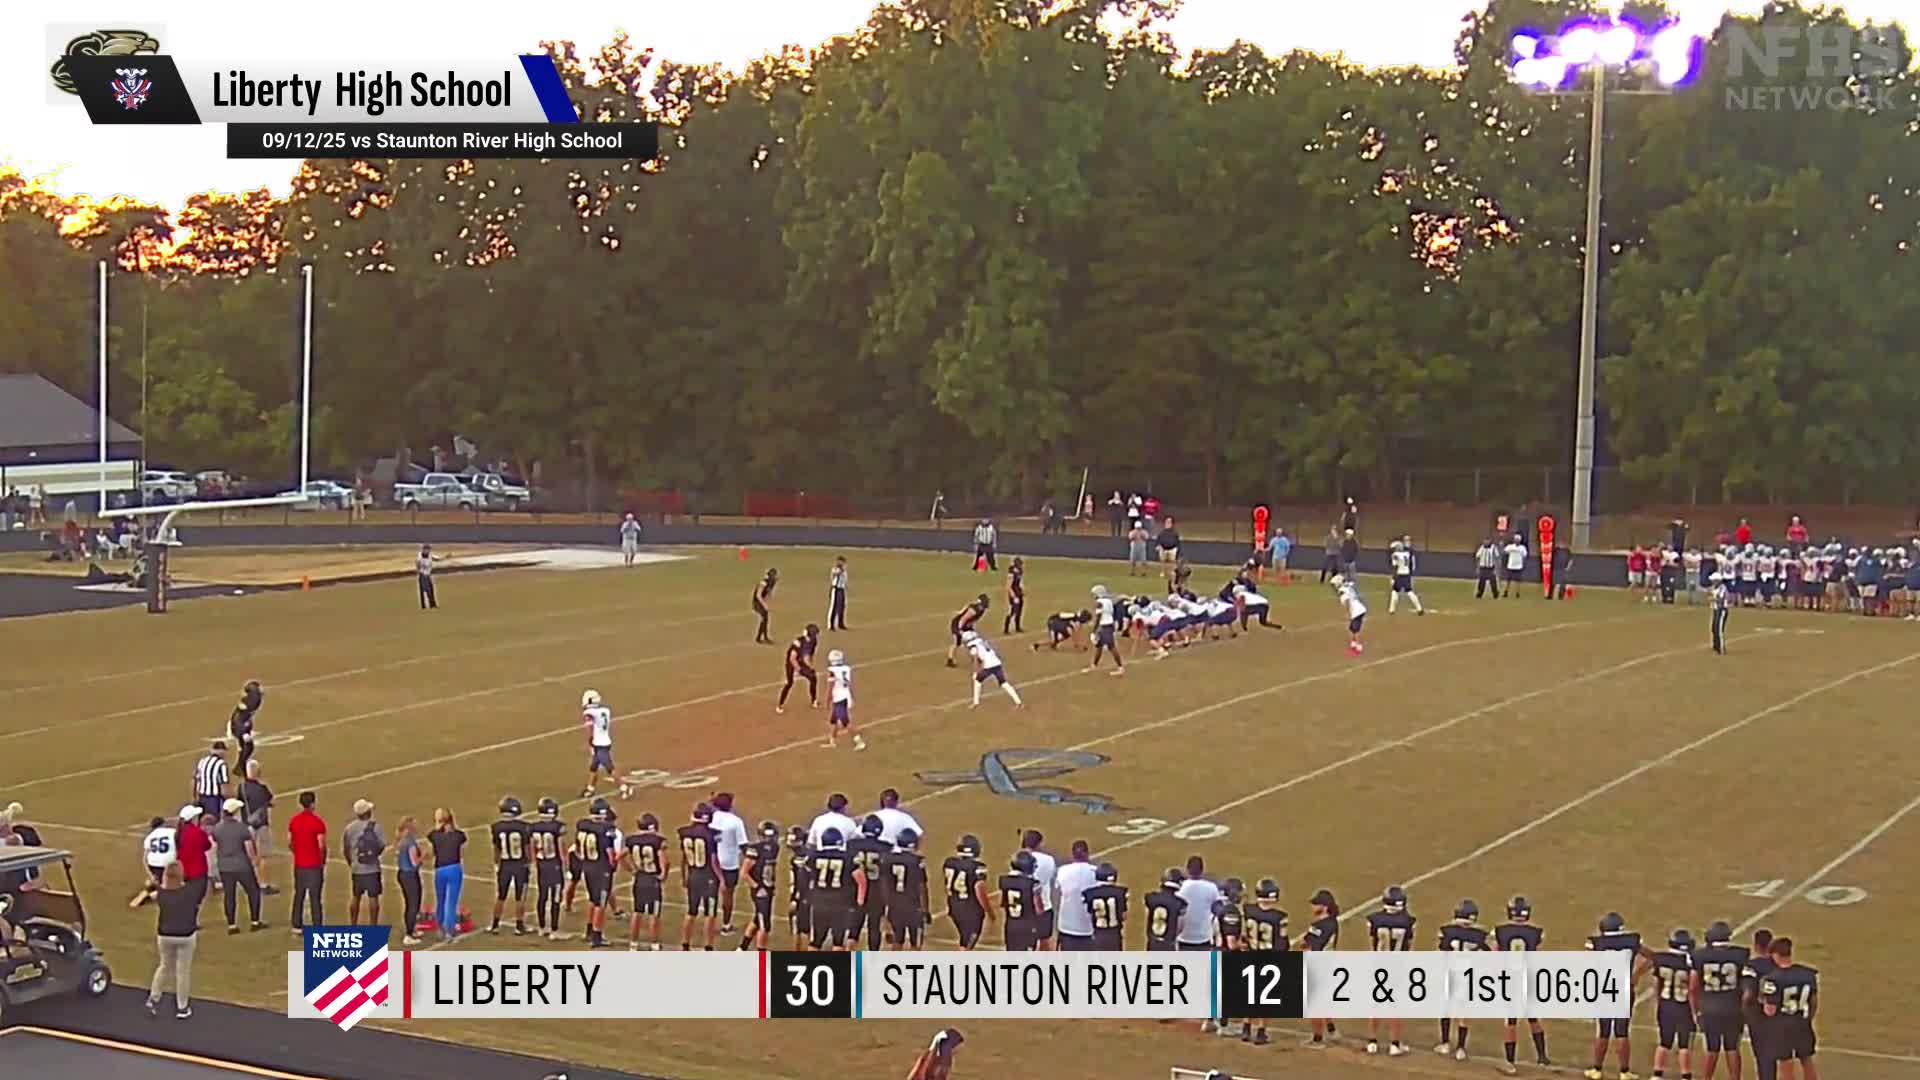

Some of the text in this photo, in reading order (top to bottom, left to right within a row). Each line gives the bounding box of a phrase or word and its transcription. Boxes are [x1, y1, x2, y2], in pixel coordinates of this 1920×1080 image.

[1106, 818, 1230, 840] 30
[815, 858, 844, 888] 77
[892, 864, 906, 892] 7
[945, 868, 969, 900] 74
[1007, 890, 1022, 917] 5
[1728, 879, 1867, 905] 40
[1092, 896, 1119, 928] 21
[1703, 962, 1737, 992] 53
[1781, 984, 1810, 1018] 54
